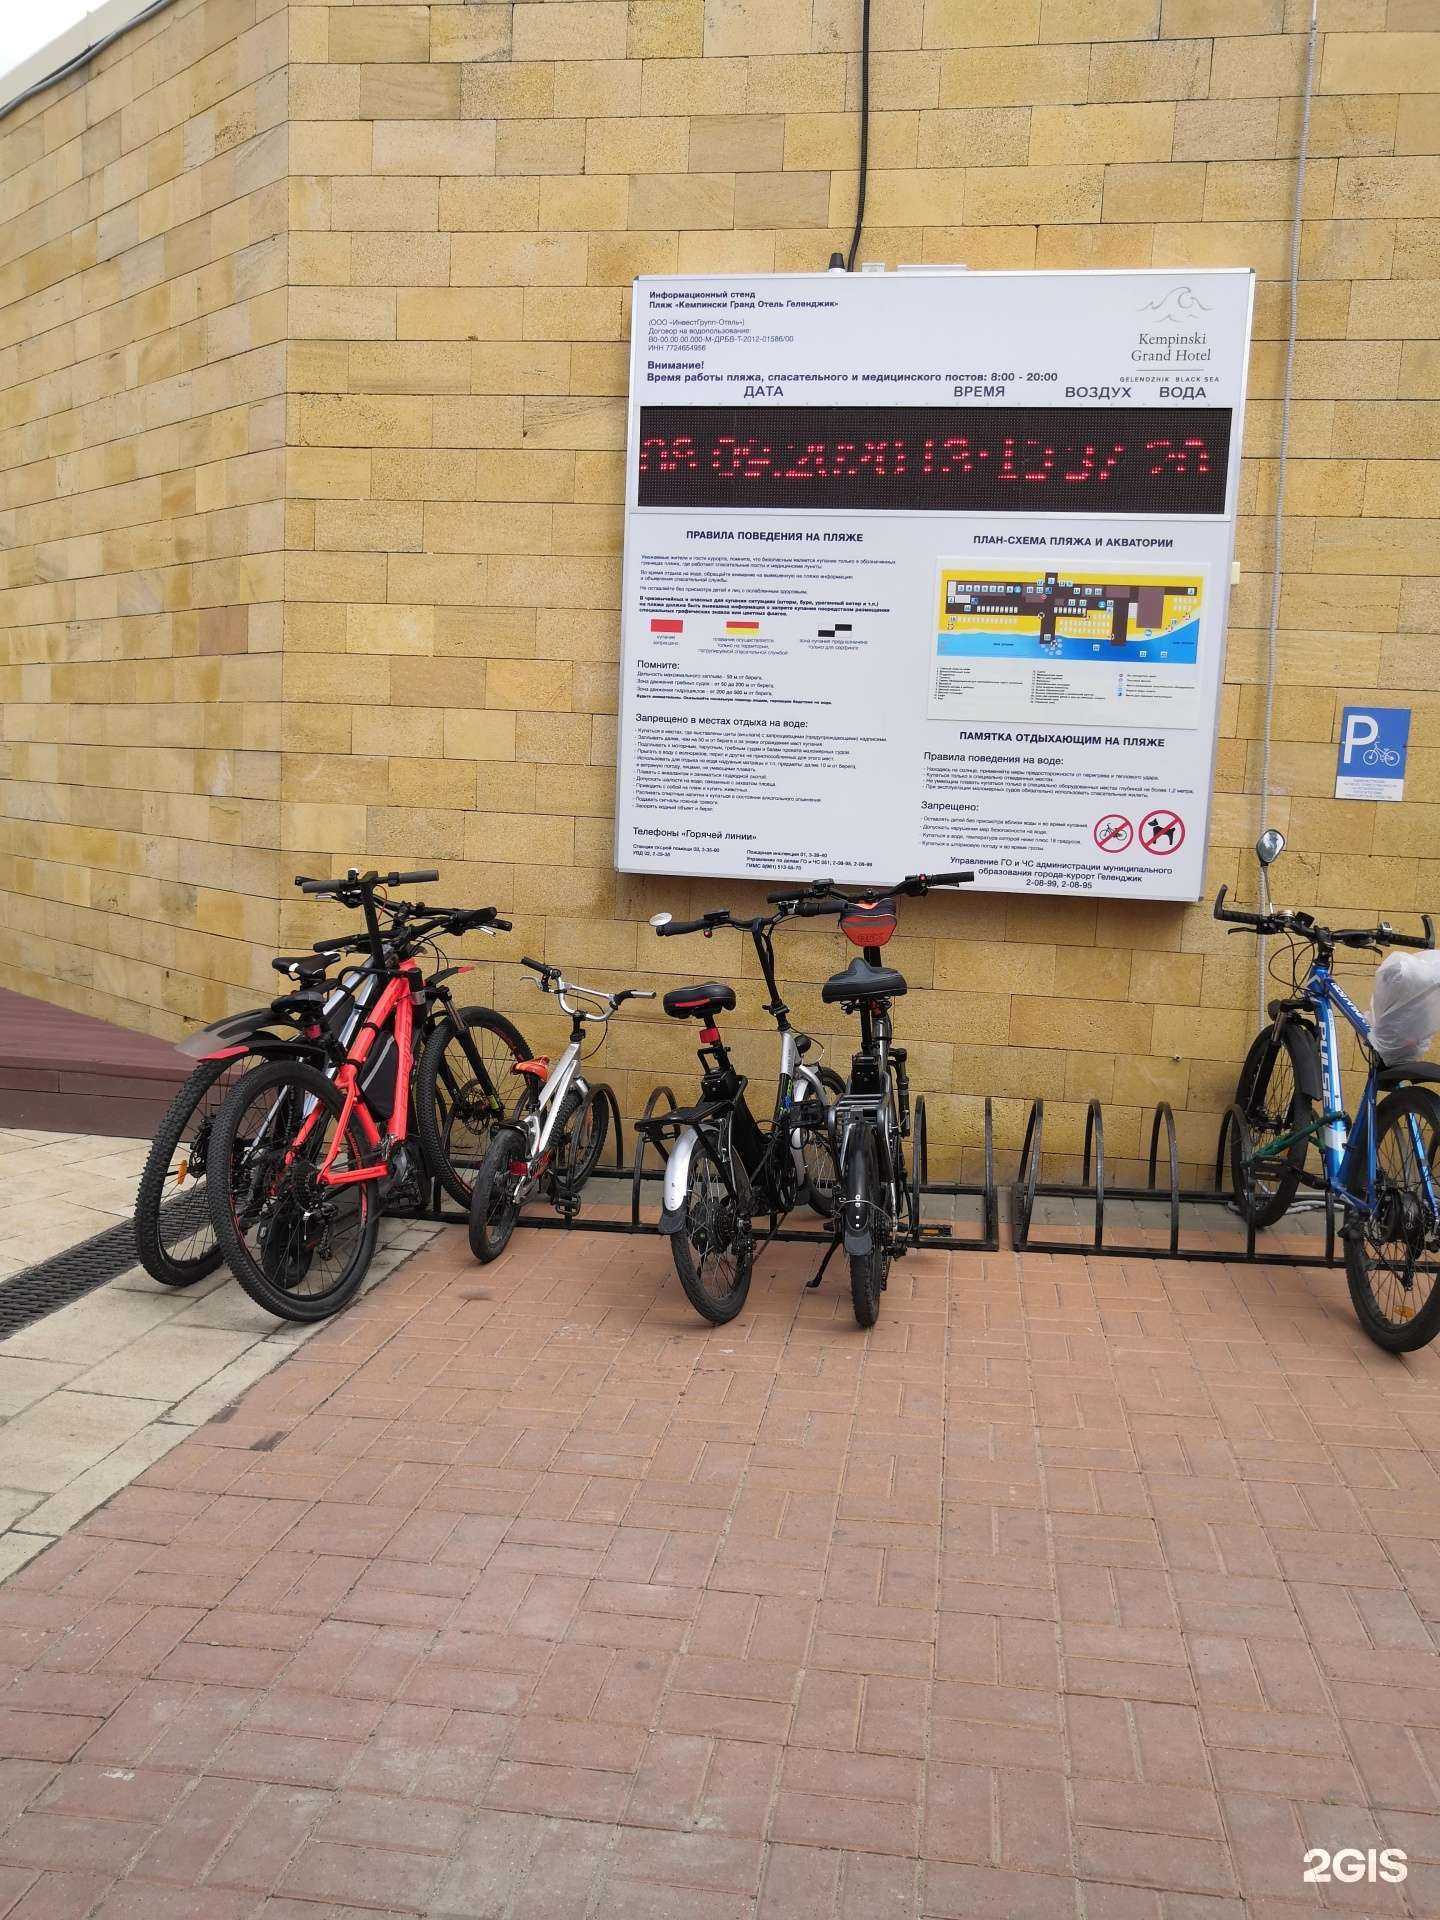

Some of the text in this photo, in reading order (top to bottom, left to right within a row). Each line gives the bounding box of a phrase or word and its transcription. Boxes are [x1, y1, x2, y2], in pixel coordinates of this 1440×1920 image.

[649, 291, 727, 299] Информационный
[730, 300, 755, 308] Гранд
[1139, 333, 1206, 347] Kempinski
[1131, 346, 1210, 361] Grand Hotel
[647, 360, 703, 369] Внимание!
[647, 372, 681, 381] Время
[684, 372, 723, 381] работы
[862, 374, 941, 382] медицинского
[990, 372, 1014, 380] 8:00
[1026, 372, 1057, 381] 20:00
[744, 385, 783, 398] ДАТА
[954, 386, 1004, 396] ВРЕМЯ
[1065, 386, 1131, 399] ВОЗДУХ
[1159, 386, 1206, 399] ВОДА
[686, 530, 862, 541] ПРАВИЛА ПОВЕДЕНИЯ НА ПЛЯЖЕ
[973, 536, 1173, 547] ПЛАН-СХЕМА ПЛЯЖА И АКВАТОРИИ
[637, 660, 679, 669] Помните:
[635, 713, 688, 724] Запрещено
[733, 719, 766, 727] отдыха
[783, 720, 807, 728] воде:
[960, 731, 1012, 741] ПАМЯТКА
[1015, 733, 1101, 745] ОТДЫХАЮЩИМ
[1123, 737, 1164, 746] ПЛЯЖЕ
[1344, 715, 1379, 763] P
[924, 751, 965, 761] Правила
[968, 755, 1020, 764] поведения
[1037, 757, 1063, 766] воде:
[921, 801, 978, 811] Запрещено:
[633, 827, 679, 837] Телефоны
[950, 856, 998, 865] Управление
[1000, 858, 1012, 866] ГО
[1021, 859, 1035, 867] ЧС
[1035, 862, 1100, 871] администрации
[1102, 865, 1172, 874] муниципального
[978, 867, 1142, 882] образования города-курорт Геленджик
[1026, 878, 1092, 889] 2-08-99, 2-08-95
[1319, 1021, 1330, 1107] PULSE
